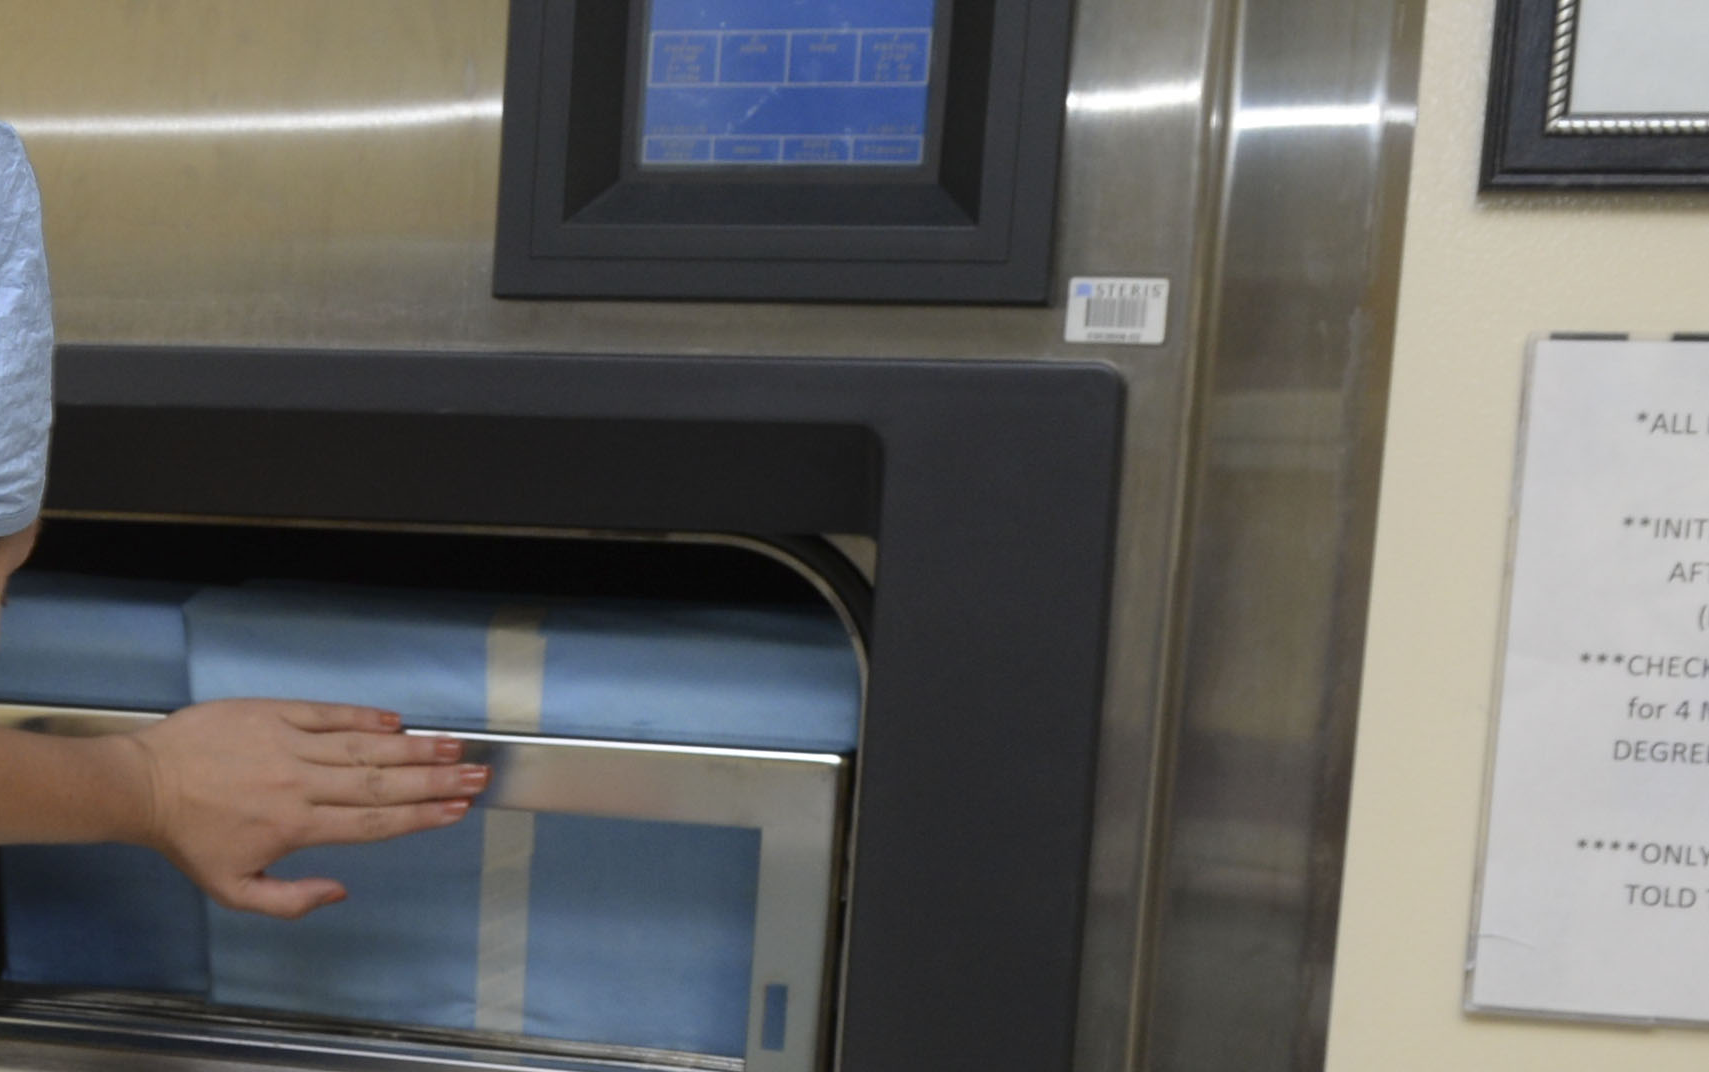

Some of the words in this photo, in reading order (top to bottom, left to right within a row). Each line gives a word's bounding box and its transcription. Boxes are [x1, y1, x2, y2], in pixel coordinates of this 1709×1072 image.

[1096, 283, 1164, 298] STERIS
[1628, 697, 1666, 720] for
[1674, 700, 1690, 720] 4
[1613, 740, 1709, 765] DEGRE
[1625, 884, 1697, 909] TOLD
